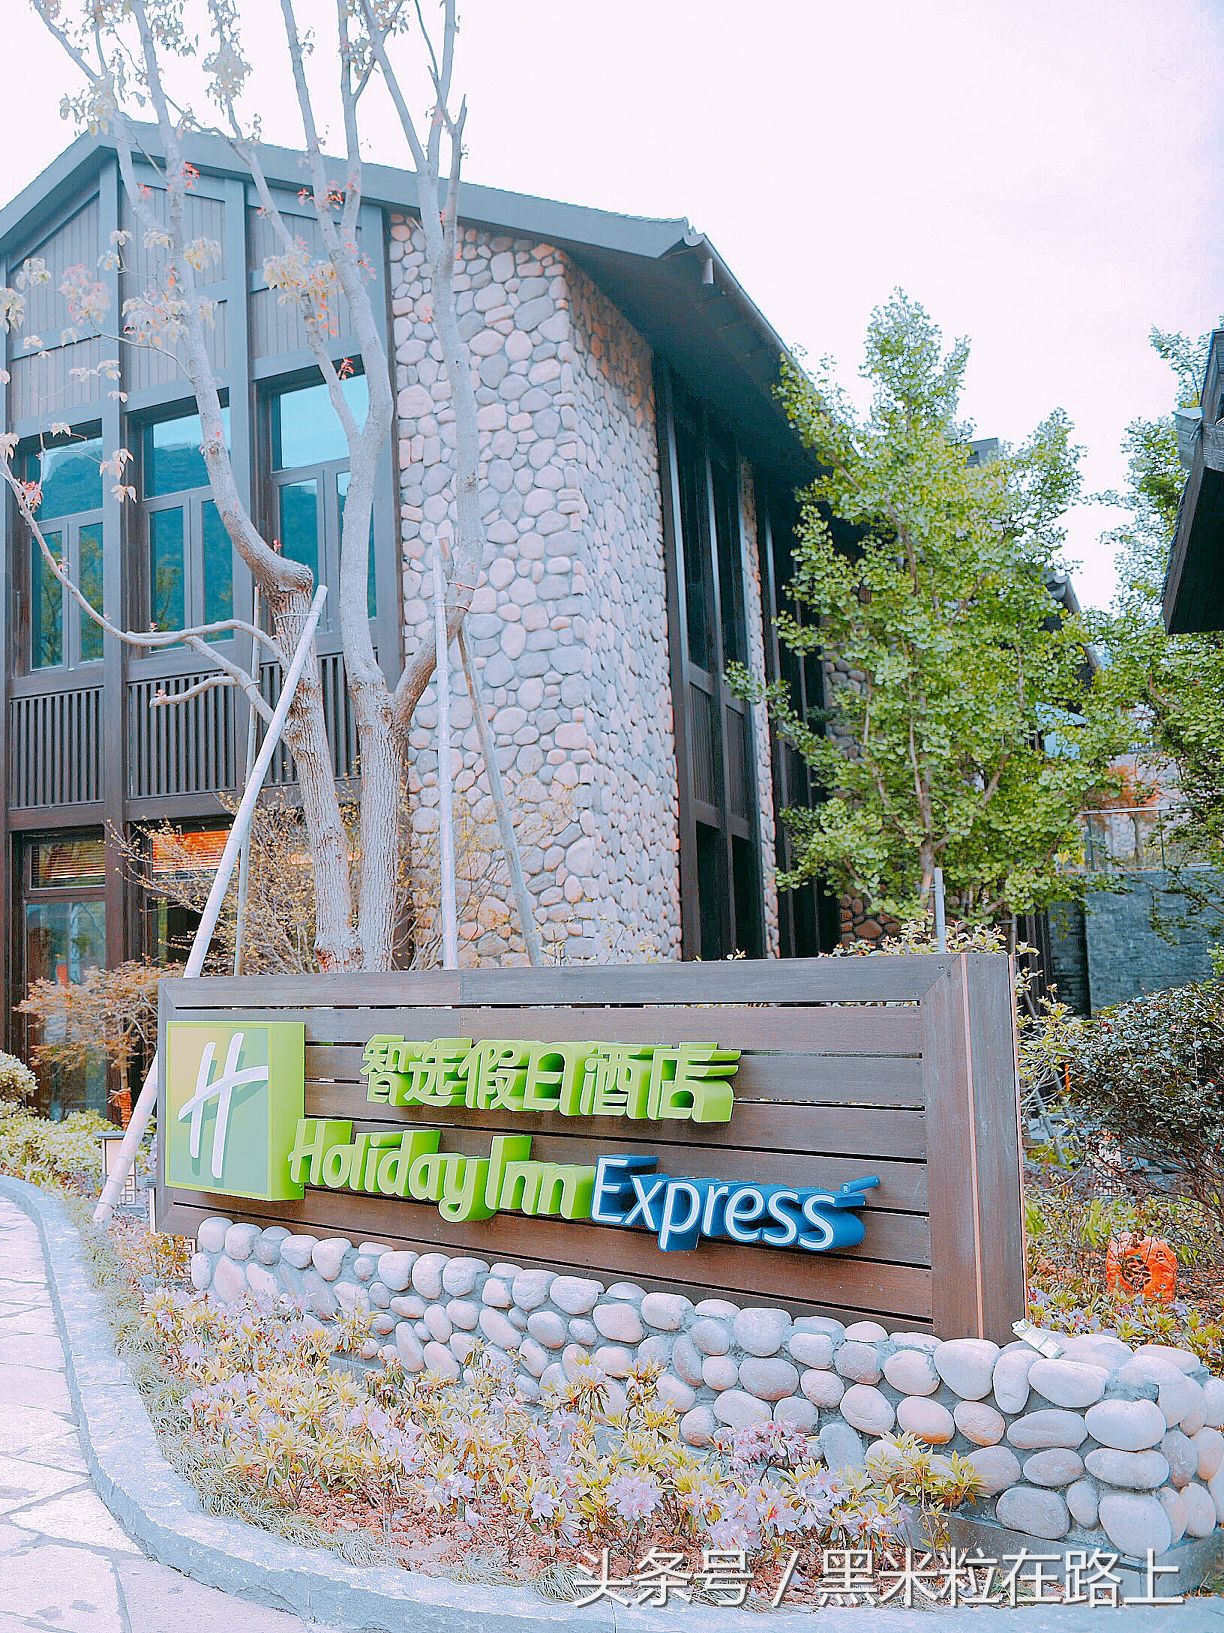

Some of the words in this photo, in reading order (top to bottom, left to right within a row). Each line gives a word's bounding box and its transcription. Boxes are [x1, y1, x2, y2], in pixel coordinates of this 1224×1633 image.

[359, 1034, 722, 1122] 智选假日酒店
[288, 1119, 484, 1223] Holiday
[484, 1135, 581, 1219] Inn
[591, 1155, 838, 1251] Express
